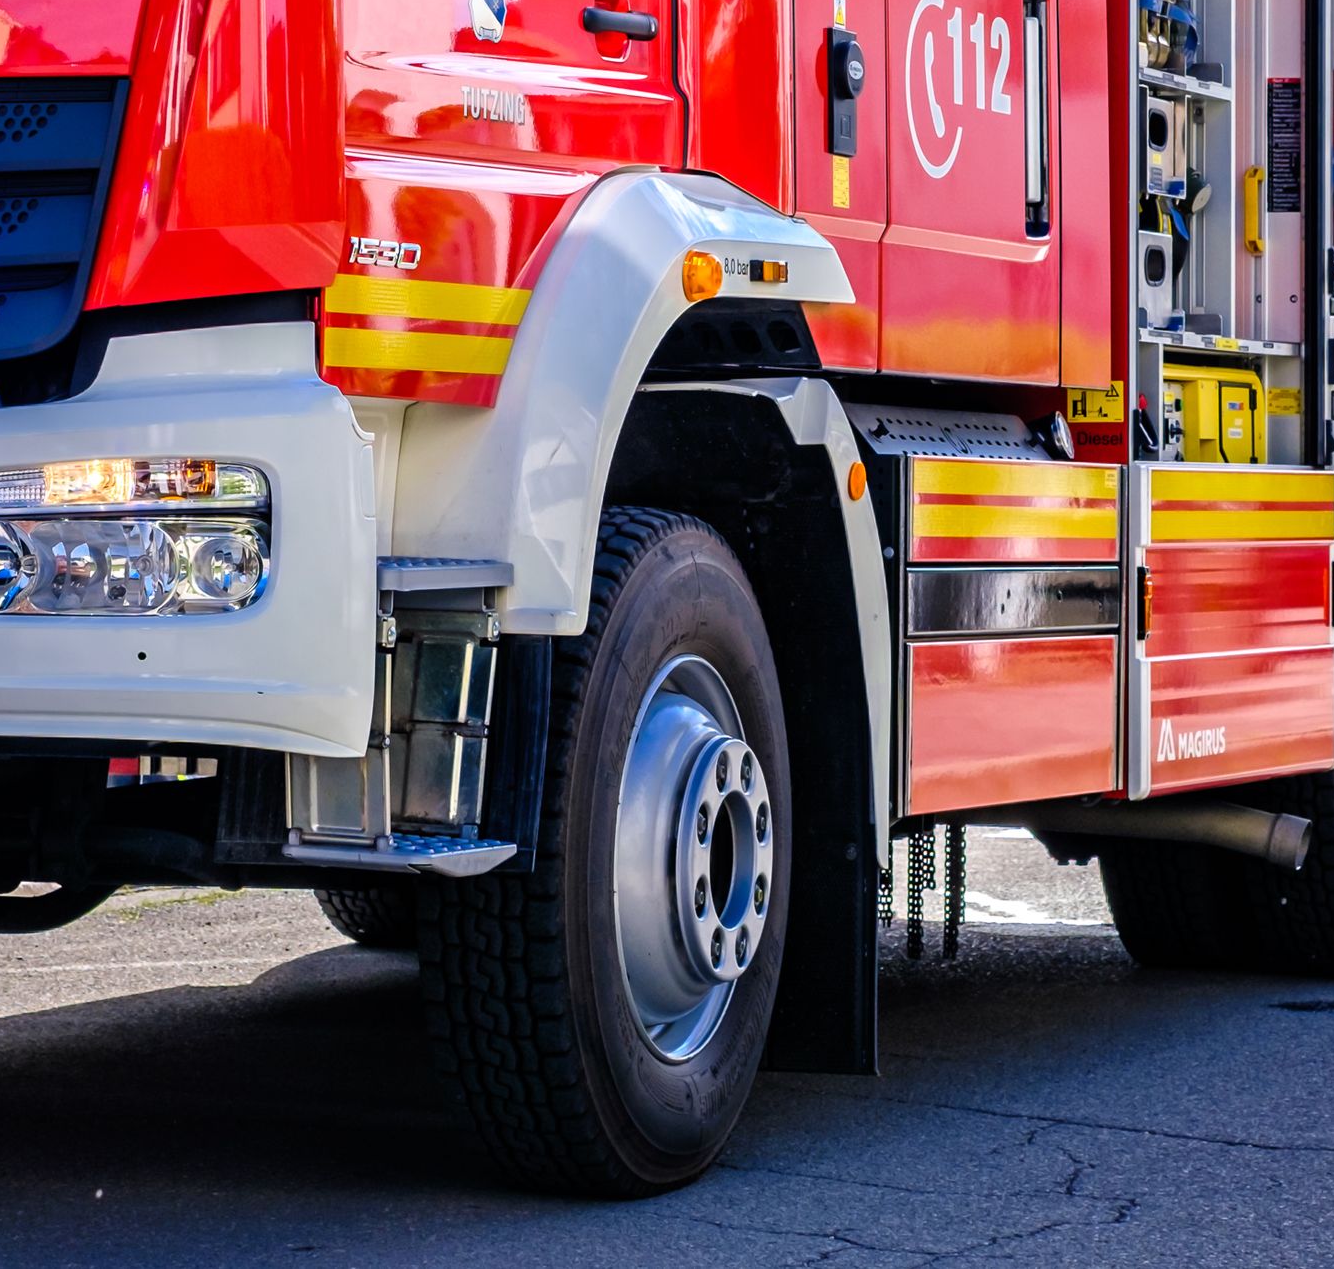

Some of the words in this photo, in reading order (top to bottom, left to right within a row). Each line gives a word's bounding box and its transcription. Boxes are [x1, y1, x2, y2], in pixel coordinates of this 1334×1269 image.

[947, 6, 1012, 115] 112
[461, 86, 526, 126] TUTZING
[349, 236, 422, 270] 1530
[724, 257, 735, 276] 8,0
[1076, 431, 1123, 446] Diesel
[1177, 725, 1227, 760] MAGIRUS
